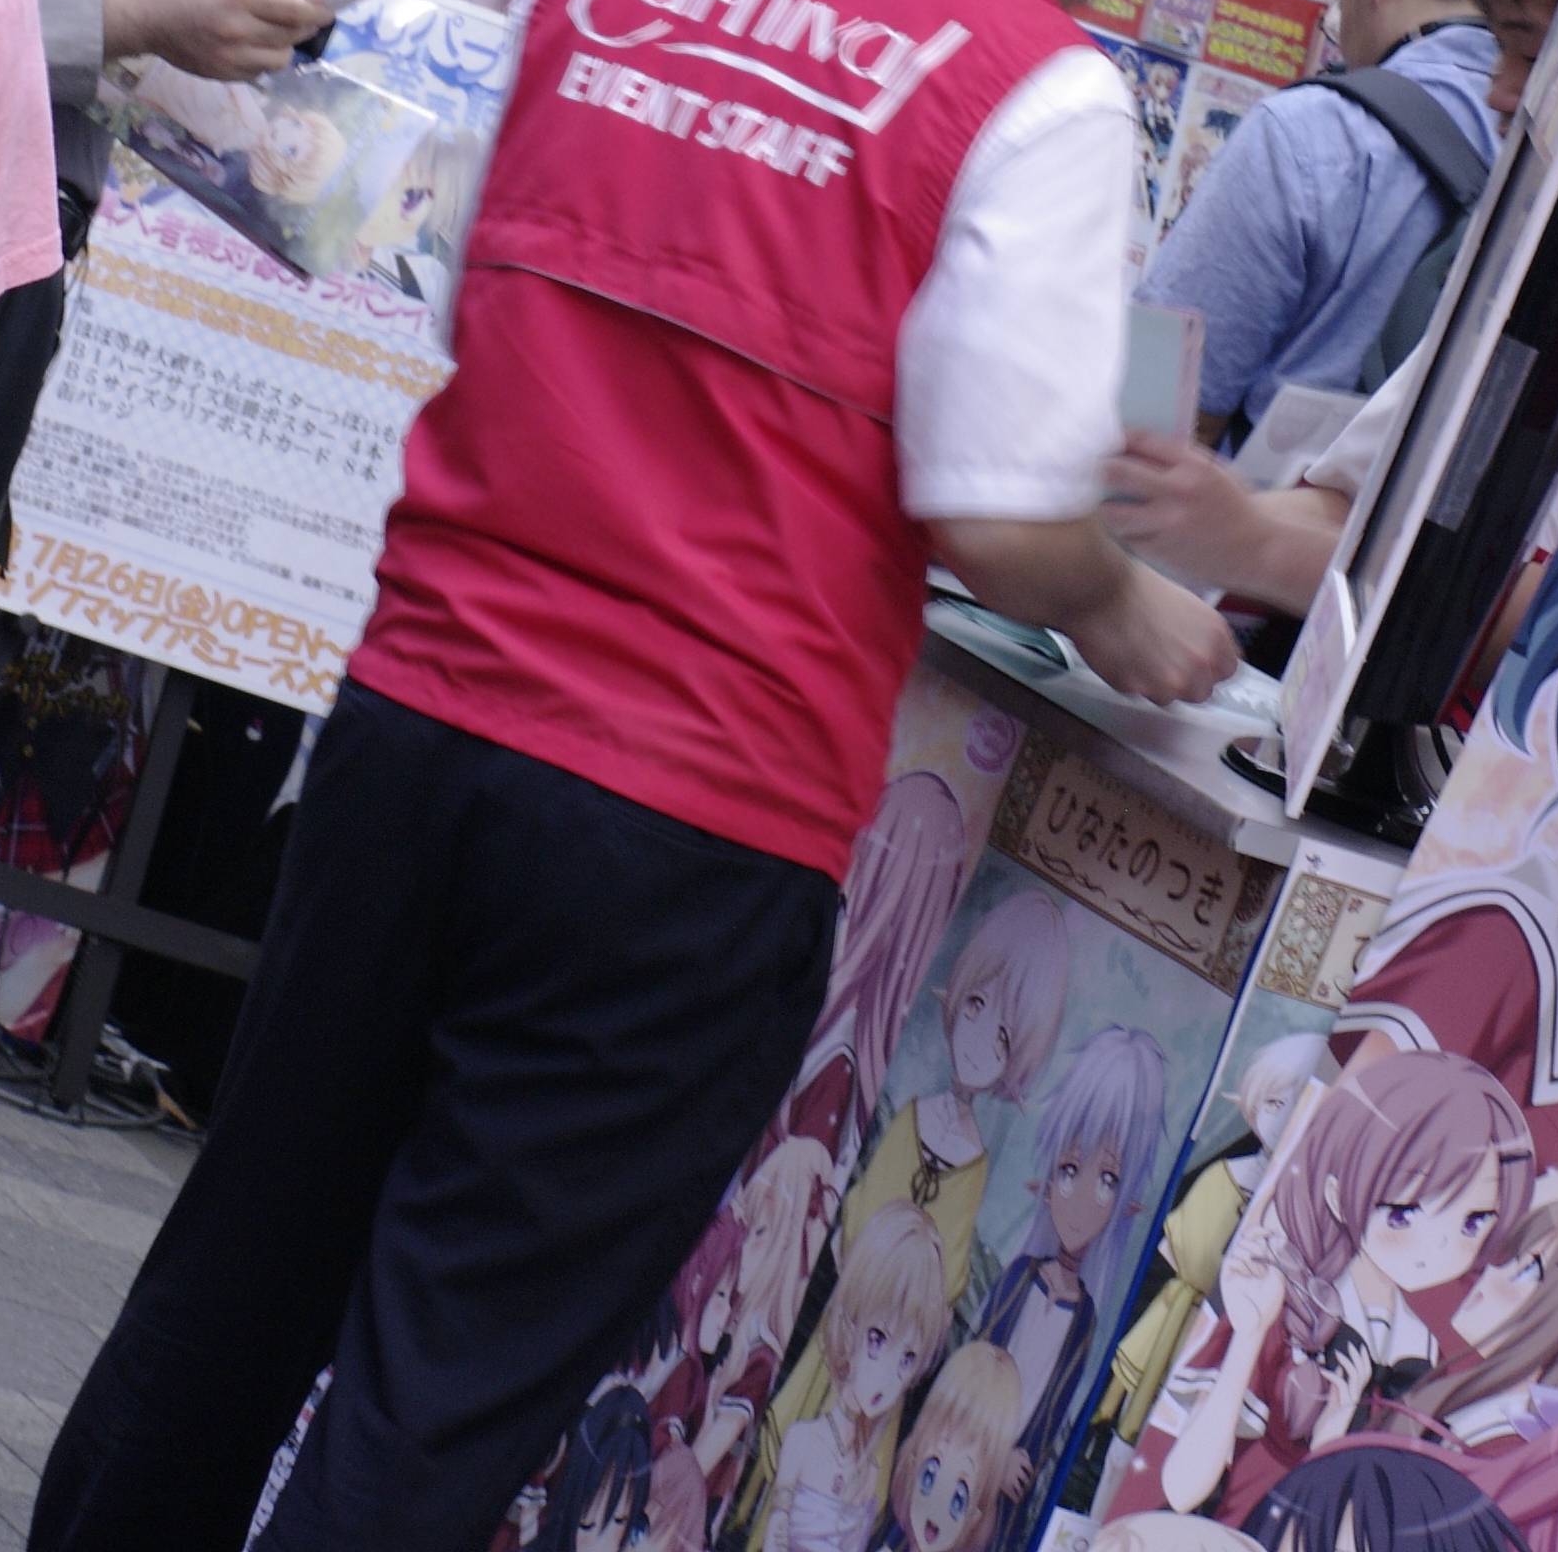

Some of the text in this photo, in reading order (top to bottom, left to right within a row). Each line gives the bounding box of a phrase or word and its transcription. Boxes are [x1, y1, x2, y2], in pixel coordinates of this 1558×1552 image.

[556, 50, 712, 140] EVENT
[695, 100, 855, 188] STAFF
[1047, 778, 1228, 928] ひなたのつき
